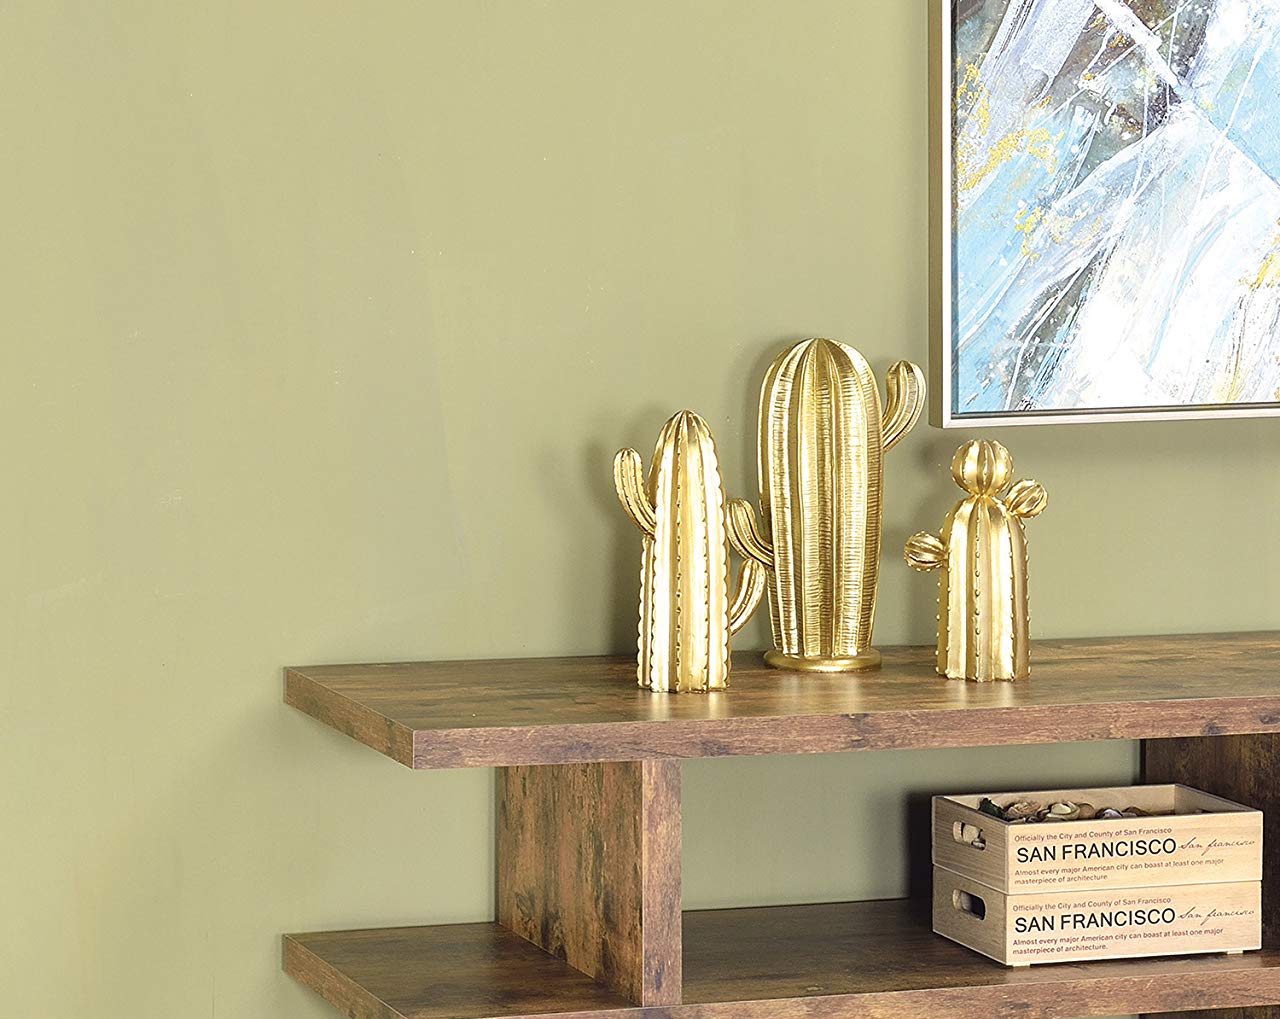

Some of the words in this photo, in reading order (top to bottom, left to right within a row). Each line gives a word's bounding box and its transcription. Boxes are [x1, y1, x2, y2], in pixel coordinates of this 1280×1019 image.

[1014, 834, 1044, 842] Officially
[1075, 831, 1087, 839] and
[1089, 830, 1113, 838] County
[1139, 827, 1172, 835] Francisco
[1017, 844, 1056, 863] SAN
[1062, 838, 1176, 860] FRANCISCO
[1179, 836, 1202, 850] San
[1041, 868, 1059, 876] every
[1061, 867, 1080, 875] major
[1082, 864, 1115, 872] American
[1116, 863, 1129, 871] city
[1144, 861, 1163, 869] boast
[1205, 858, 1224, 866] major
[1015, 877, 1056, 885] masterpiece
[1013, 904, 1043, 912] Officially
[1088, 900, 1113, 908] County
[1138, 897, 1171, 905] Francisco
[1178, 906, 1202, 919] San
[1015, 915, 1055, 933] SAN
[1061, 908, 1175, 930] FRANCISCO
[1039, 938, 1058, 946] every
[1060, 937, 1080, 945] major
[1081, 934, 1113, 942] American
[1204, 928, 1223, 936] major
[1013, 947, 1055, 955] masterpiece
